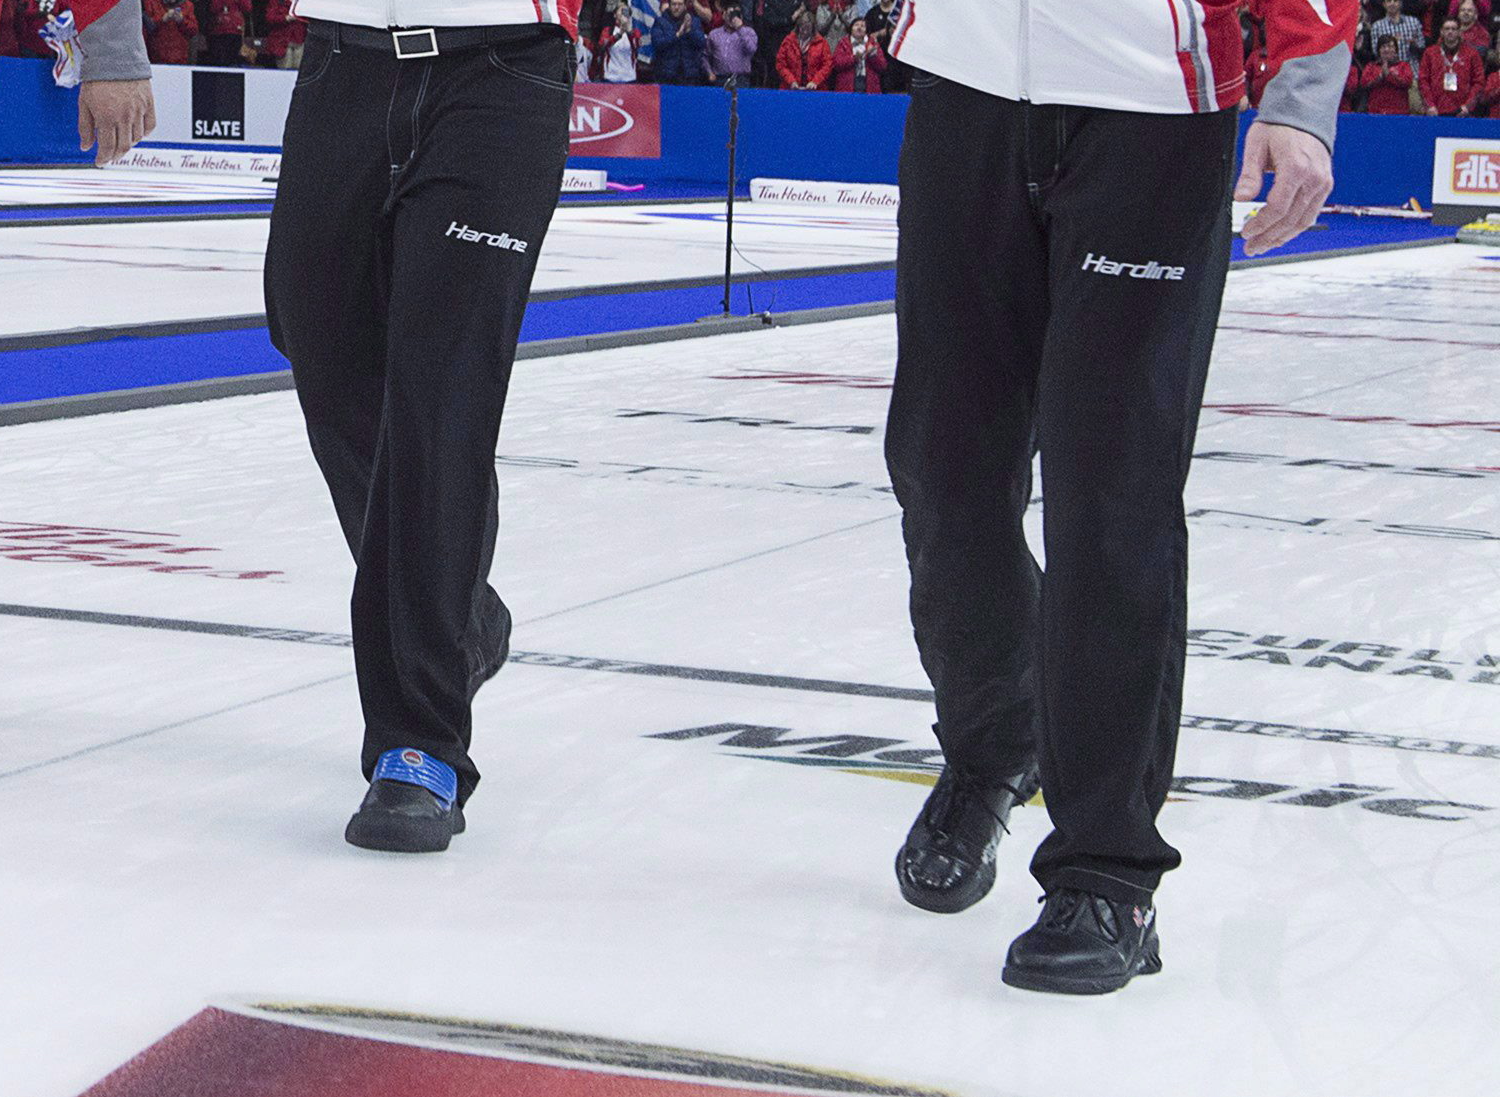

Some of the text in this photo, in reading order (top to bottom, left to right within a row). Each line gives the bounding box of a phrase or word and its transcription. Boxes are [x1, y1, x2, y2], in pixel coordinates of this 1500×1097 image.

[195, 120, 240, 137] SLATE
[132, 154, 173, 169] Hortons
[180, 154, 200, 169] Tim
[201, 155, 242, 170] Hortons
[250, 157, 269, 171] Tim
[758, 185, 780, 201] Tim
[781, 184, 827, 203] Hortons
[836, 189, 858, 203] Tim
[445, 221, 528, 253] Hardline
[1082, 253, 1185, 280] Hardline
